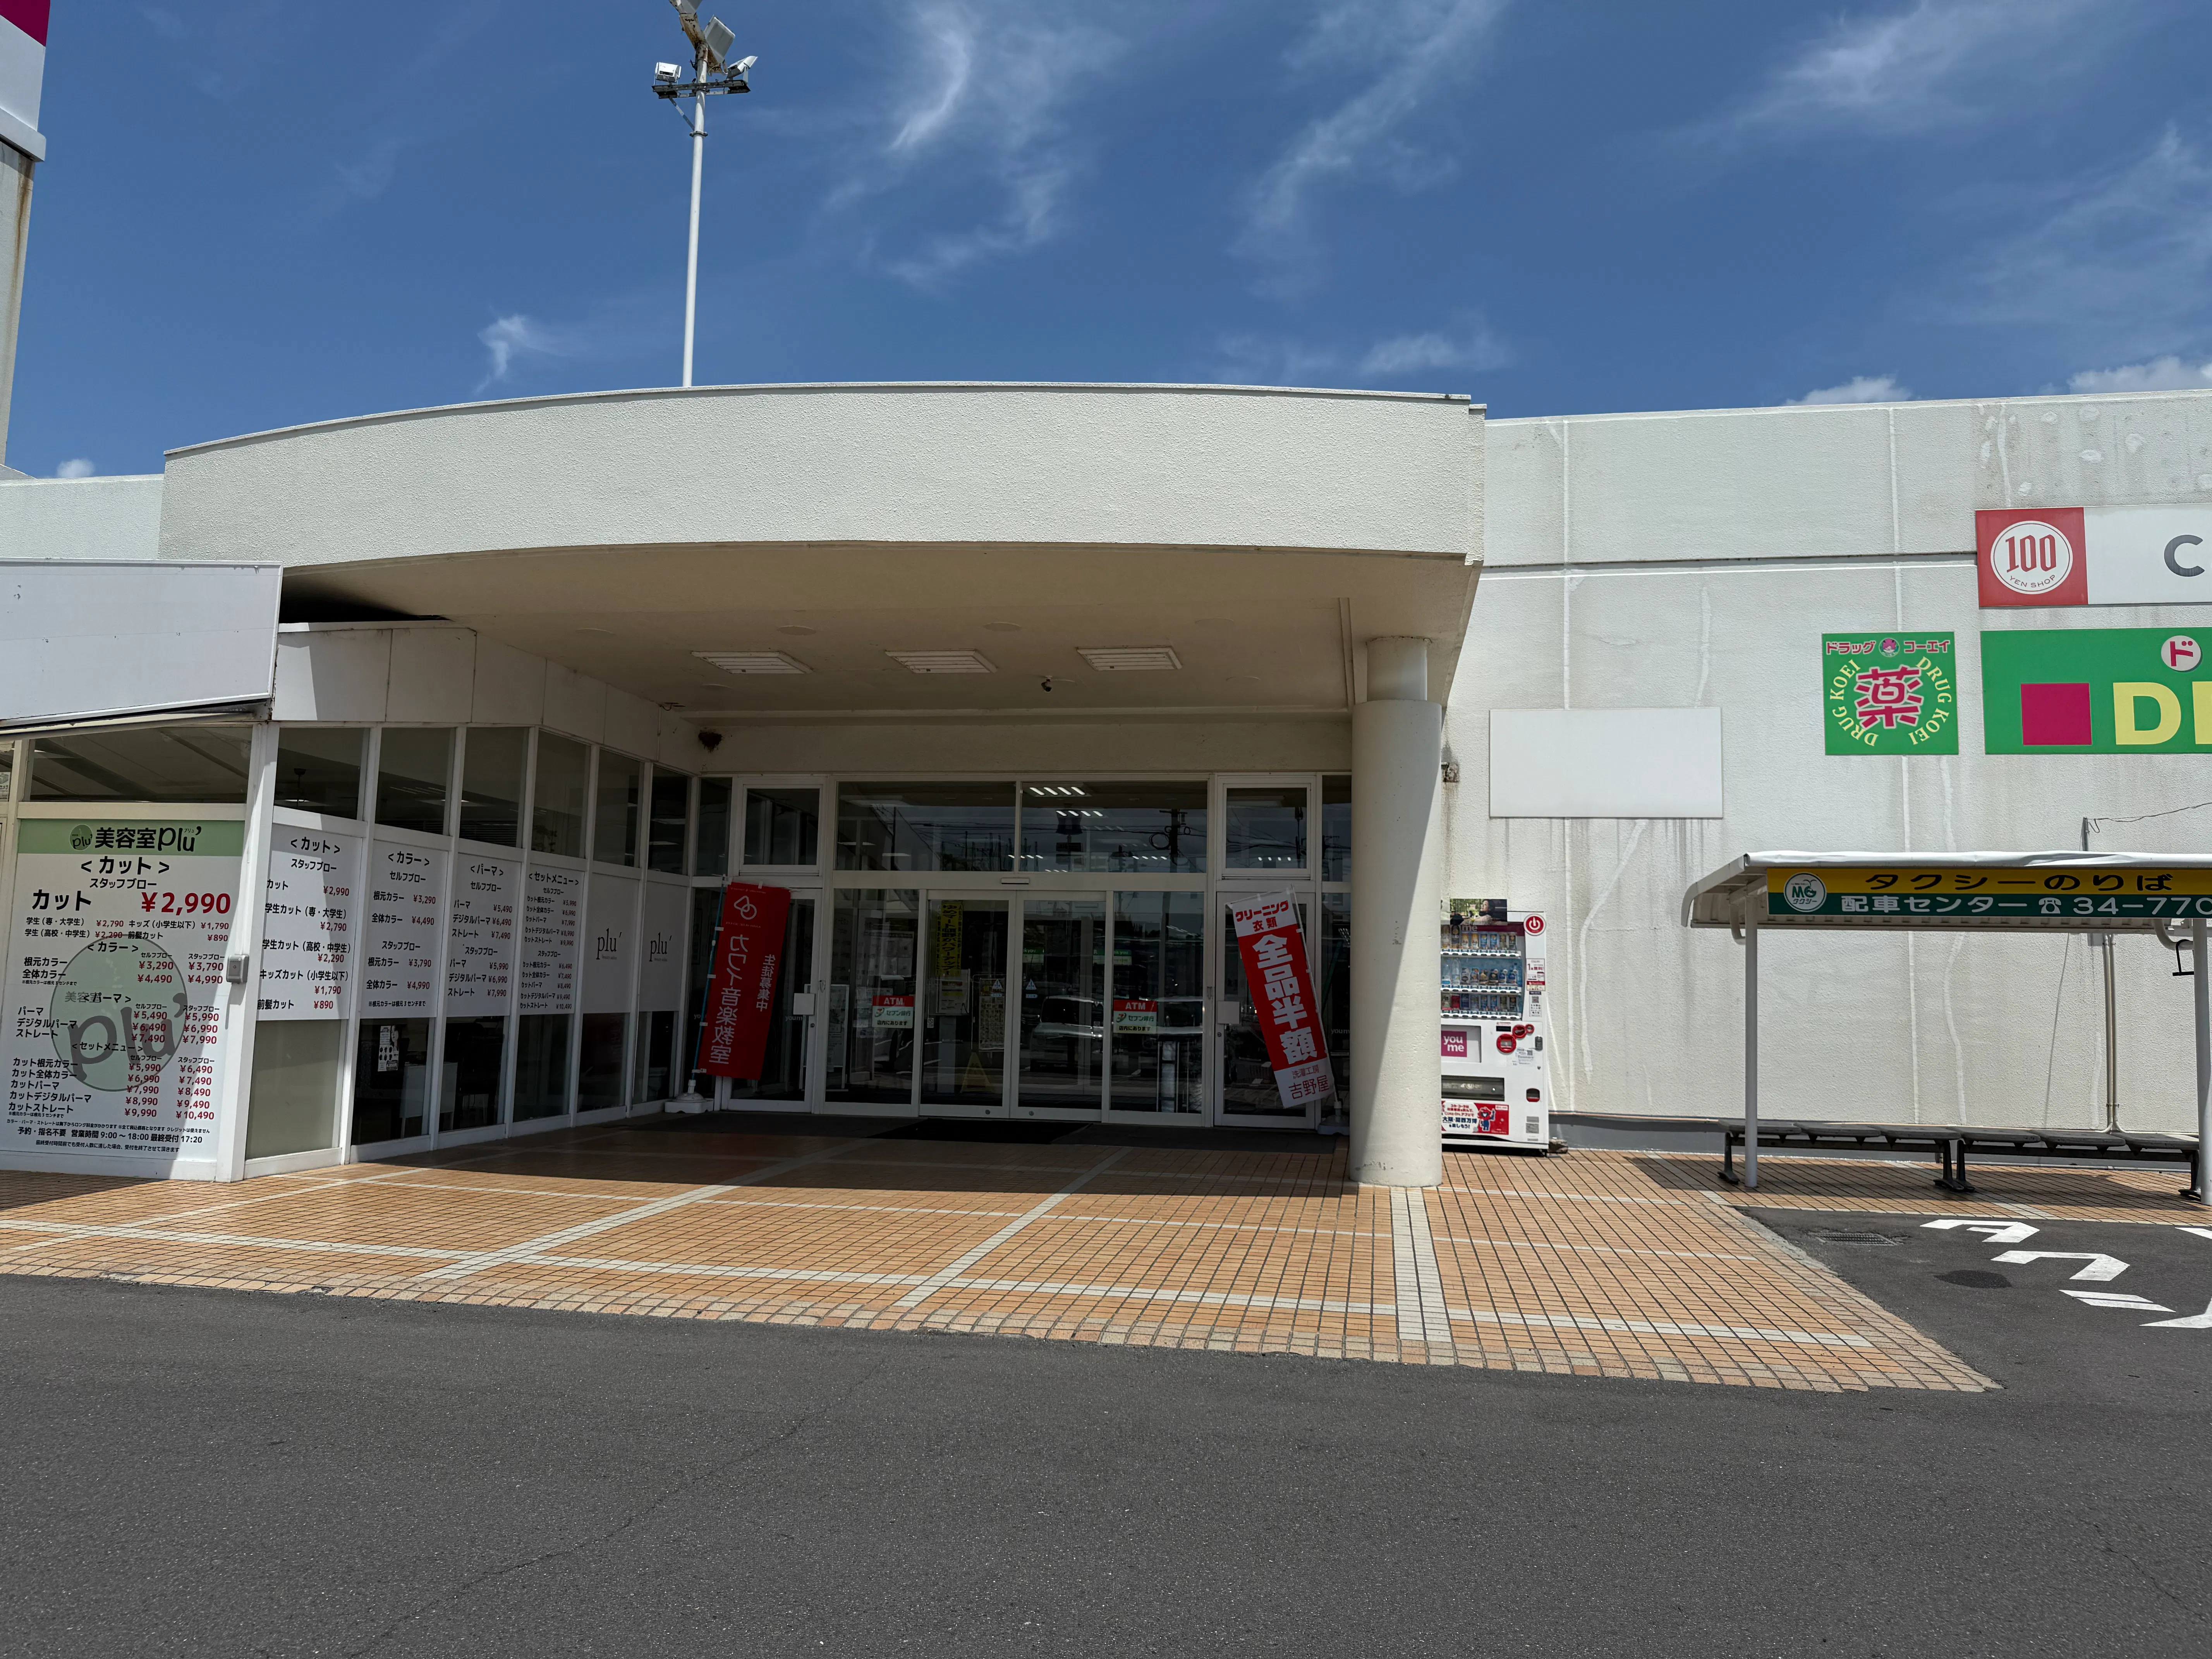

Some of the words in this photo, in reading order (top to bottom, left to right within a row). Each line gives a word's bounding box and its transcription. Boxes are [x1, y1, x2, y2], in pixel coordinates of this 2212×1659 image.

[2006, 534, 2057, 573] 100
[2009, 574, 2027, 588] YEN
[2030, 574, 2056, 588] SHOP
[1826, 641, 1875, 655] ドラッグ
[1904, 640, 1950, 654] コーエイ
[2170, 640, 2194, 667] ド
[1830, 659, 1861, 701] KOEI
[1916, 656, 1952, 703] DRUG
[1854, 665, 1925, 730] 薬
[1832, 704, 1879, 747] DRUG
[1908, 706, 1949, 746] KOEI
[291, 858, 337, 872] スタッフブロー
[90, 877, 157, 890] スタッフブロー
[390, 871, 426, 883] セルフブロー
[1865, 874, 2173, 891] タクシーのりば
[267, 879, 289, 890] カット
[323, 886, 349, 896] ¥2,990
[471, 881, 501, 892] セルフブロー
[32, 890, 91, 911] カット
[141, 892, 230, 916] ¥2,990
[373, 891, 404, 901] 根元カラー
[414, 894, 436, 905] ¥3,290
[1842, 896, 2027, 913] 配車センター
[454, 899, 471, 909] パーマ
[493, 903, 513, 913] ¥5,490
[1235, 900, 1288, 922] クリーニング
[26, 917, 85, 926] 学生(専・大学生)
[96, 919, 124, 928] ¥2,790
[129, 920, 196, 930] キッズ(小学生以下)
[201, 922, 229, 930] ¥1,790
[321, 921, 347, 932] ¥2,790
[372, 914, 403, 924] 全体カラー
[412, 915, 434, 926] ¥4,490
[453, 914, 490, 925] デジタルパーマ
[492, 917, 512, 926] ¥6,490
[1252, 917, 1278, 932] 衣類
[25, 929, 90, 938] 学生(高校・中学生)
[95, 931, 123, 939] ¥2,290
[128, 931, 163, 940] 前髪カット
[452, 928, 479, 939] ストレート
[491, 931, 511, 940] ¥7,490
[381, 940, 421, 950] スタッフブロー
[465, 946, 498, 955] スタッフブロー
[24, 957, 67, 967] 根元カラー
[139, 961, 174, 971] ¥3,290
[189, 962, 223, 972] ¥3,790
[318, 953, 344, 963] ¥2,290
[368, 957, 399, 967] 根元カラー
[409, 958, 431, 968] ¥3,790
[450, 958, 466, 967] パーマ
[489, 962, 508, 970] ¥5,990
[22, 969, 66, 979] 全体カラー
[138, 974, 172, 984] ¥4,490
[188, 975, 223, 985] ¥4,990
[449, 973, 487, 983] デジタルパーマ
[488, 975, 507, 984] ¥6,990
[315, 985, 341, 994] ¥1,790
[366, 980, 397, 989] 全体カラー
[407, 981, 430, 990] ¥4,990
[448, 988, 475, 997] ストレート
[487, 989, 507, 998] ¥7,990
[1252, 934, 1317, 1065] 全品半額
[257, 999, 294, 1010] 前髪カット
[314, 1000, 333, 1010] ¥890
[883, 997, 904, 1005] ATM
[1125, 1002, 1146, 1010] ATM
[18, 1006, 43, 1016] パーマ
[134, 1010, 167, 1020] ¥5,490
[185, 1012, 219, 1022] ¥5,990
[17, 1018, 77, 1029] デジタルパーマ
[132, 1023, 166, 1032] ¥6,490
[184, 1024, 218, 1034] ¥6,990
[16, 1029, 58, 1038] ストレート
[131, 1034, 165, 1043] ¥7,490
[182, 1035, 217, 1044] ¥7,990
[1444, 1034, 1463, 1044] you
[1448, 1044, 1464, 1052] me
[13, 1058, 78, 1068] カット根元カラー
[129, 1062, 161, 1072] ¥5,990
[180, 1064, 213, 1074] ¥6,490
[12, 1068, 77, 1080] カット全体カラー
[128, 1074, 160, 1084] ¥6,990
[179, 1076, 212, 1085] ¥7,490
[10, 1080, 60, 1091] カットパーマ
[127, 1085, 159, 1095] ¥7,990
[178, 1087, 211, 1097] ¥8,490
[1288, 1075, 1329, 1100] 吉野屋
[10, 1091, 91, 1103] カットデジタルパーマ
[125, 1096, 158, 1106] ¥8,990
[177, 1099, 210, 1109] ¥9,490
[9, 1101, 74, 1113] カットストレート
[124, 1108, 157, 1118] ¥9,990
[176, 1111, 214, 1120] ¥10,490
[71, 1129, 99, 1139] 営業時間
[129, 1133, 149, 1141] 18:00
[151, 1133, 179, 1143] 最終受付
[181, 1135, 203, 1144] 17:20
